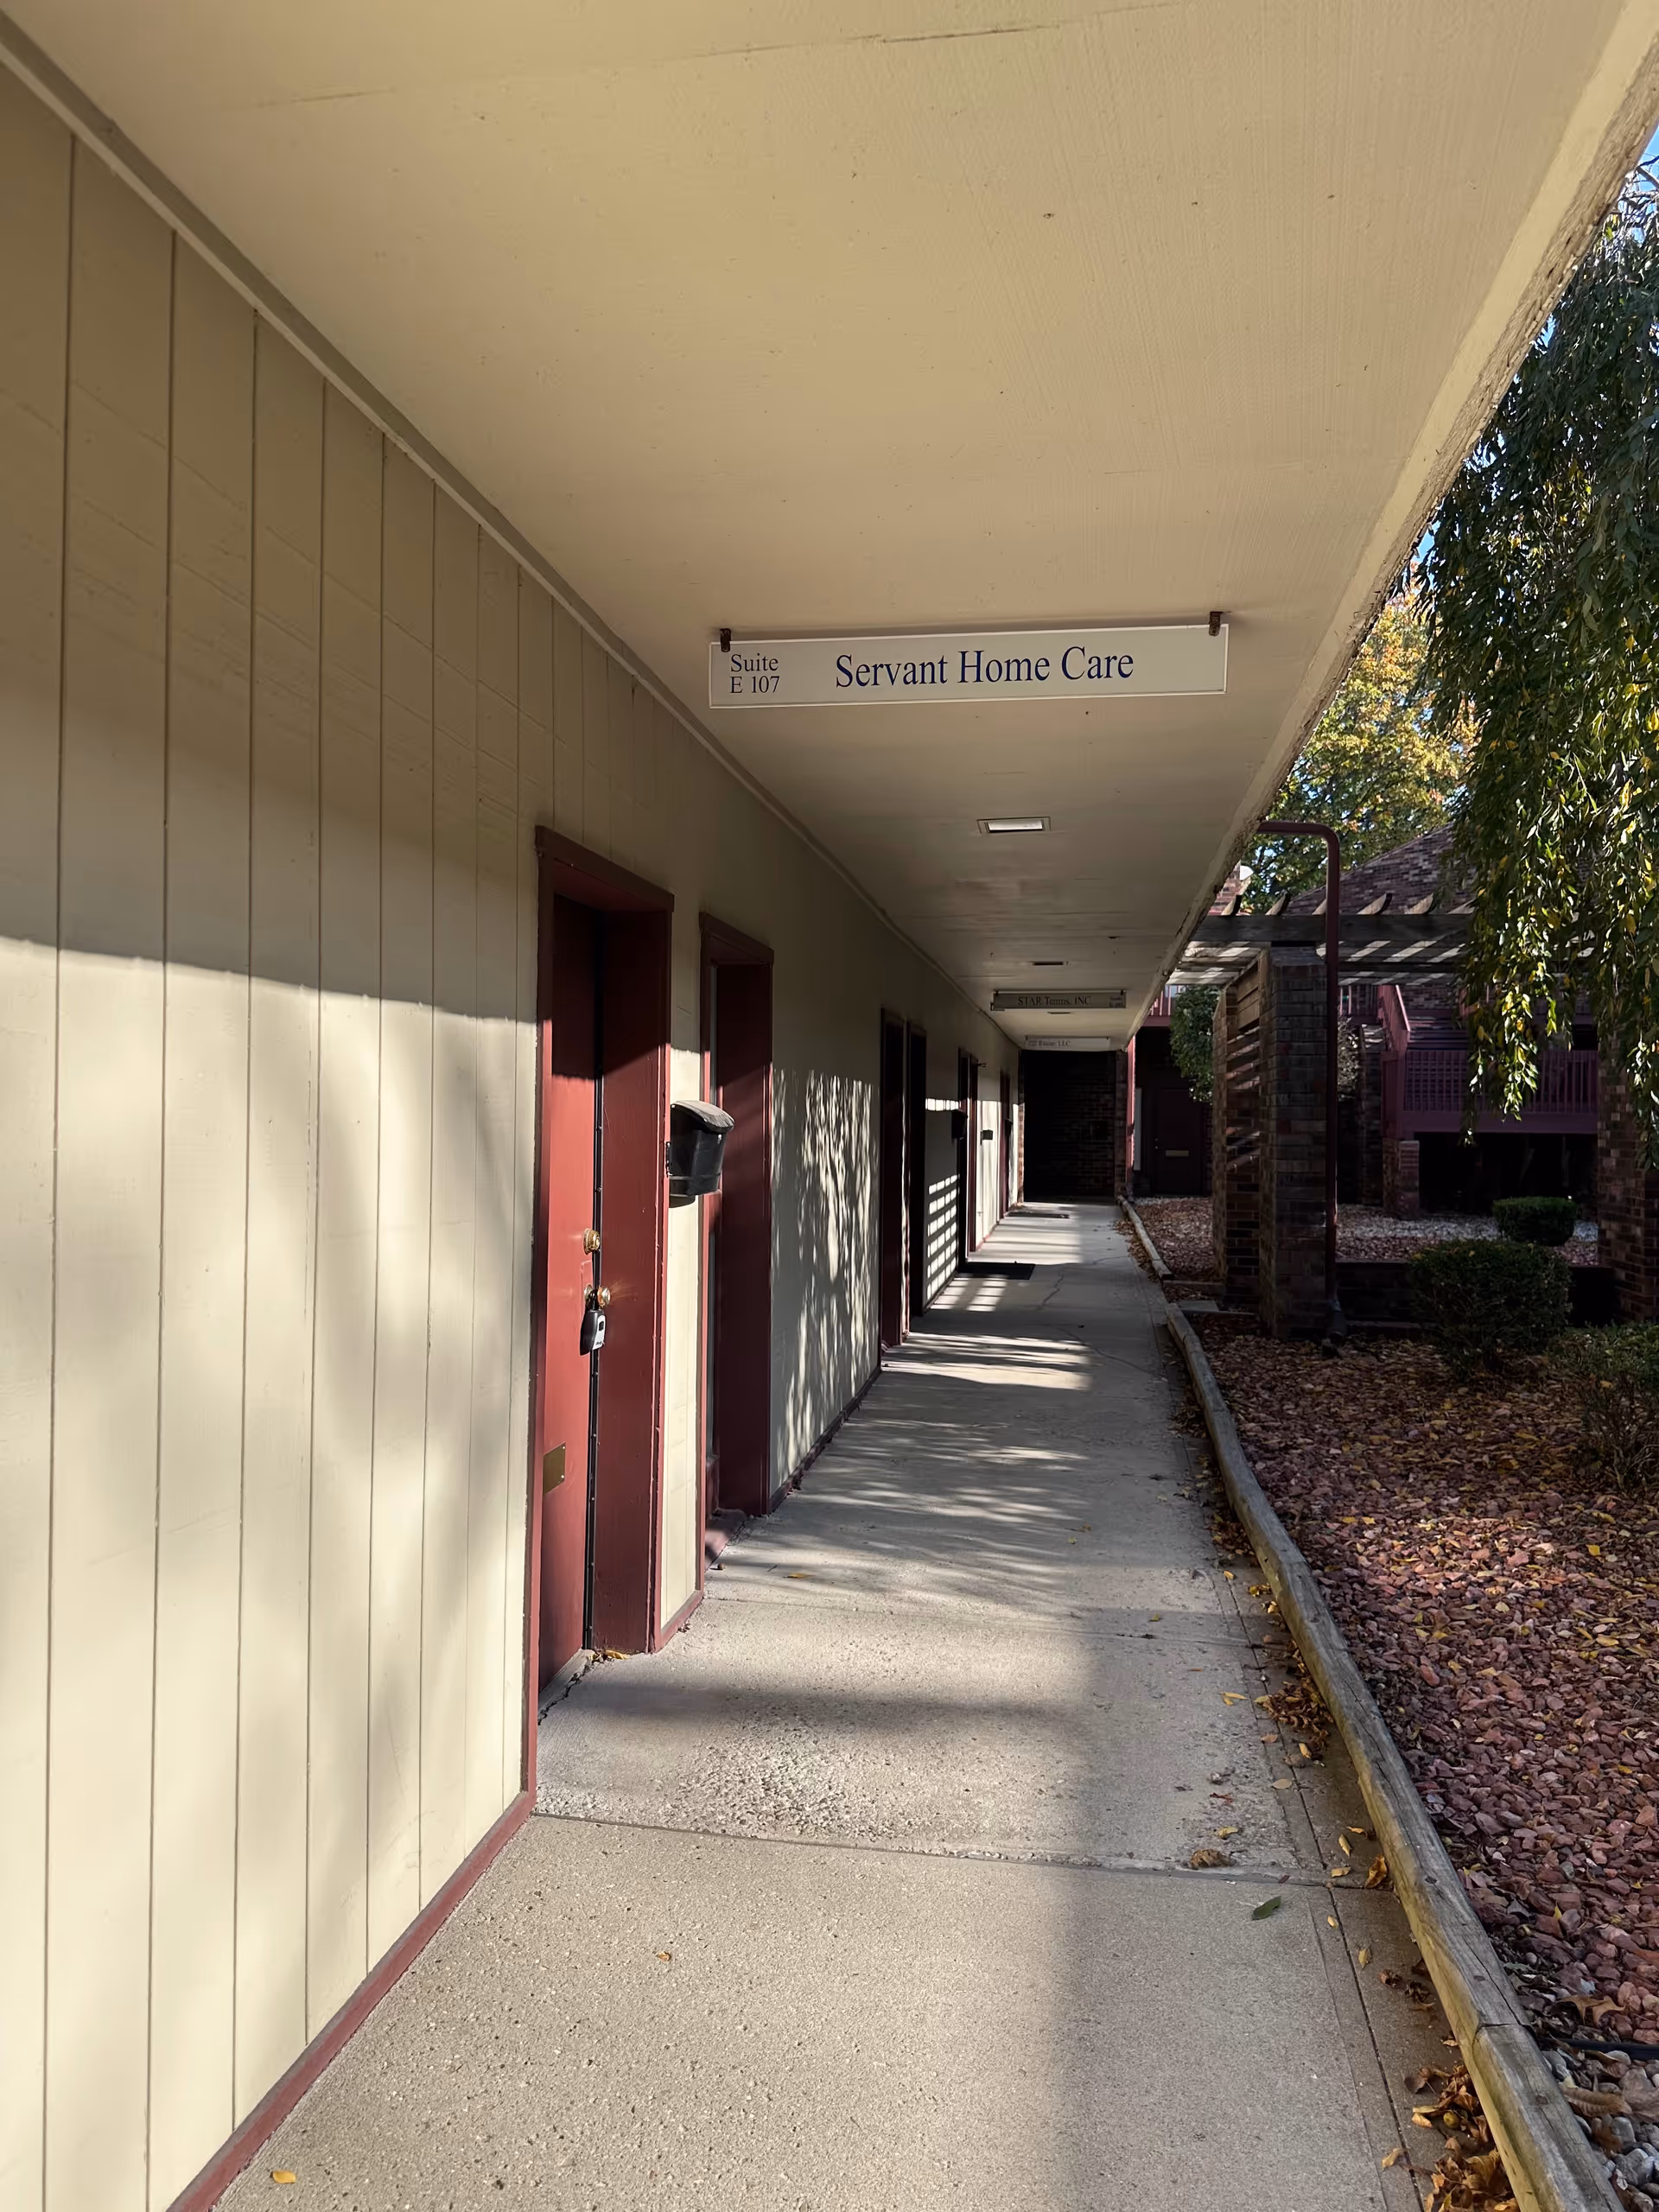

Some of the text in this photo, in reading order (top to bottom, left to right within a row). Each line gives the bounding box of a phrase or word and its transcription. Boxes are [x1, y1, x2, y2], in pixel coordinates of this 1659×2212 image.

[730, 652, 779, 672] Suite
[836, 645, 1135, 689] Servant Home Care
[729, 675, 780, 694] E 107
[1017, 996, 1041, 1006] STAR
